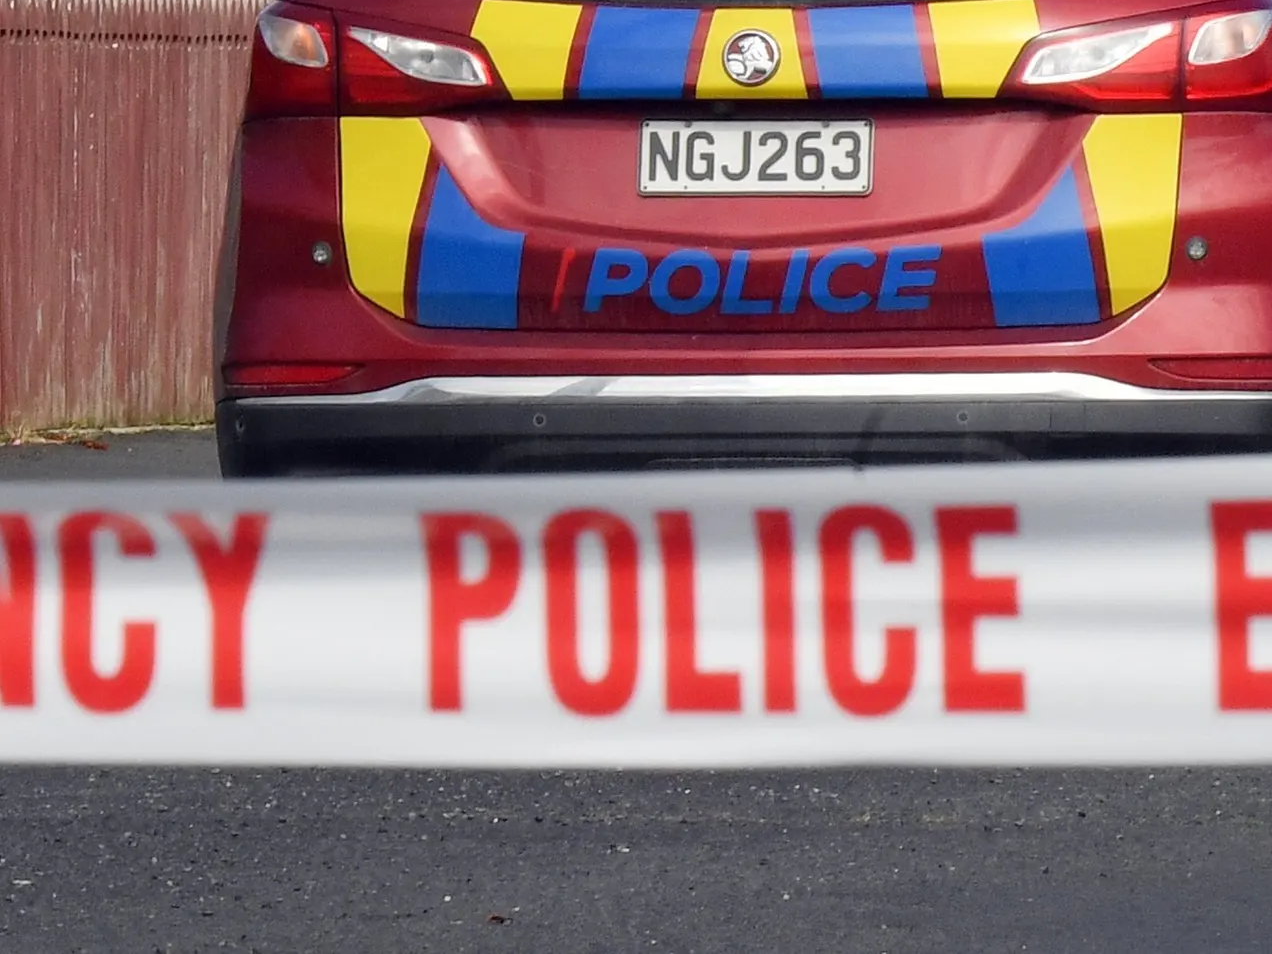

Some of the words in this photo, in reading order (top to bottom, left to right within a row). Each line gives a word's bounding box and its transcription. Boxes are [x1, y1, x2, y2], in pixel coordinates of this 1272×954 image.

[648, 130, 862, 182] NGJ263
[583, 244, 942, 315] POLICE
[419, 502, 1027, 718] POLICE
